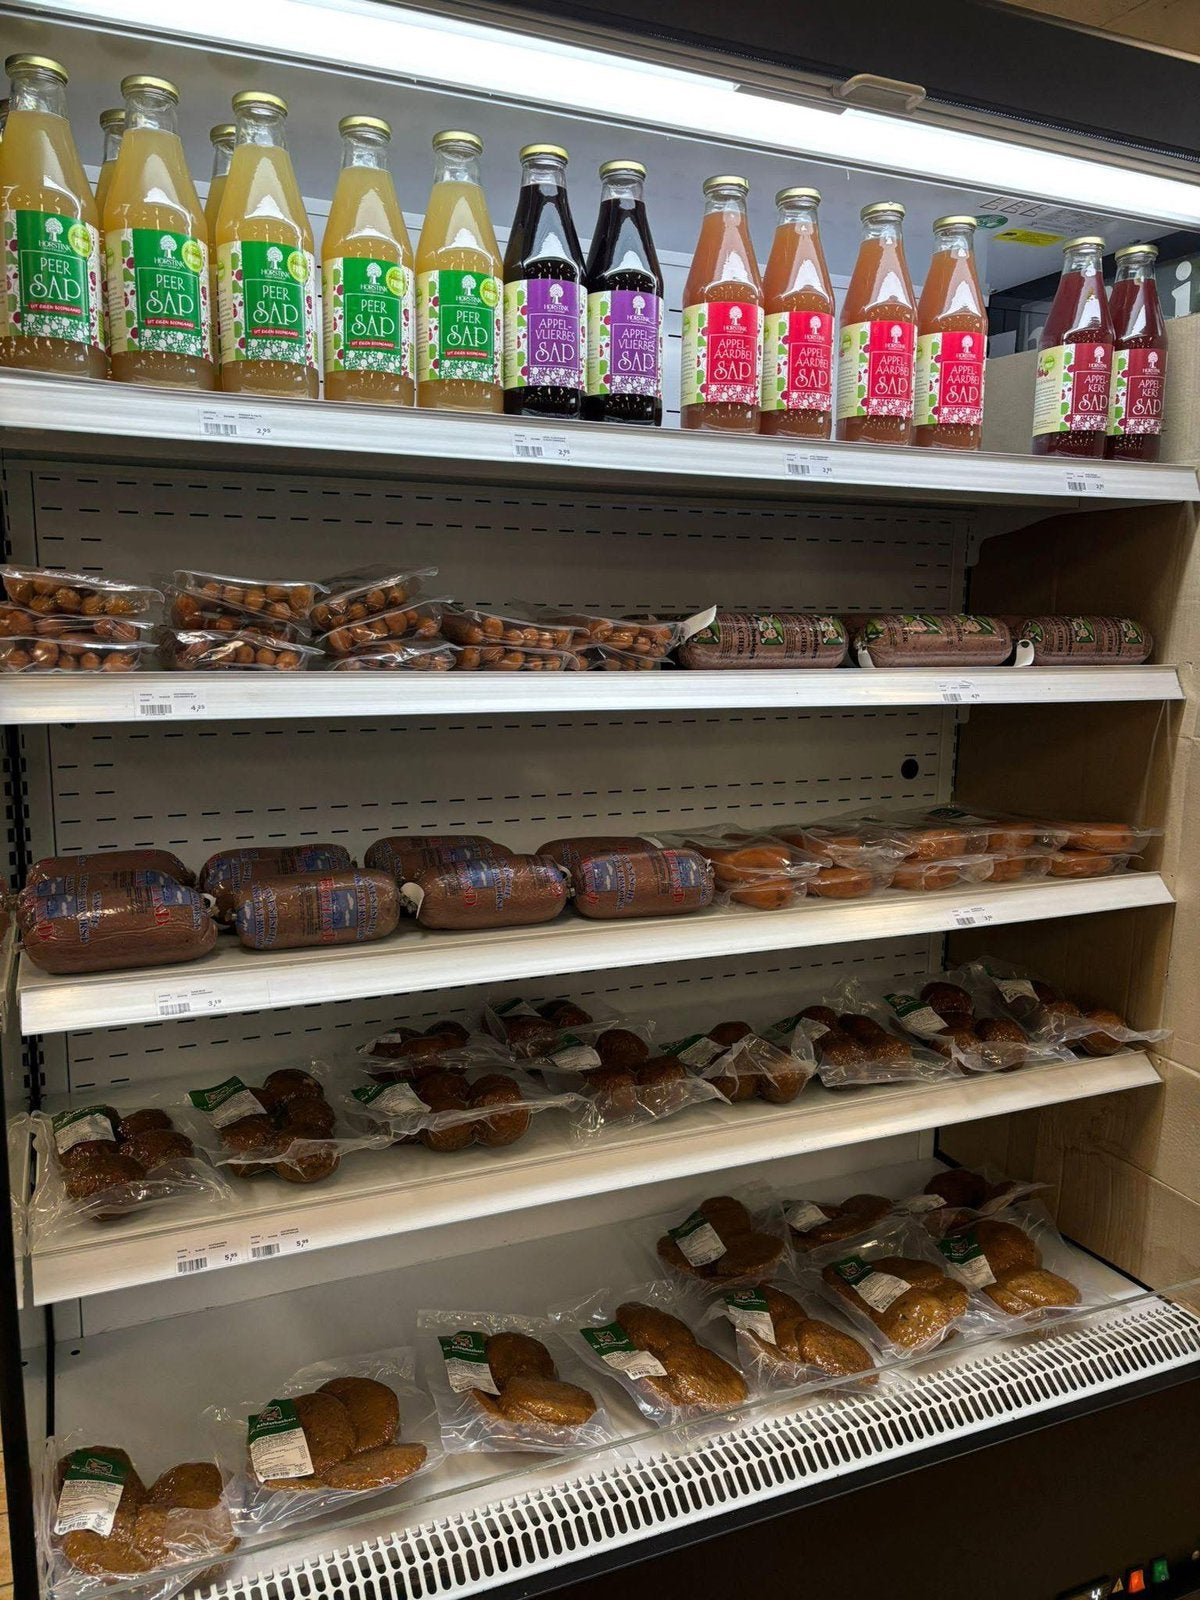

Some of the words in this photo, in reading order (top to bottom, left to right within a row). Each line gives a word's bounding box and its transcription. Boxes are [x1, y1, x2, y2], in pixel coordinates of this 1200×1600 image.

[40, 257, 72, 276] PEER
[29, 273, 82, 301] SAP
[156, 274, 186, 291] PEER
[262, 284, 290, 301] PEER
[146, 290, 194, 316] SAP
[361, 299, 387, 314] PEER
[252, 300, 298, 326] SAP
[456, 310, 481, 324] PEER
[351, 314, 394, 337] SAP
[538, 318, 572, 330] APPEL-
[446, 324, 488, 347] SAP
[535, 330, 576, 342] VLIERBES
[718, 338, 750, 349] APPEL-
[535, 342, 574, 363] SAP
[618, 350, 654, 372] SAP
[714, 349, 752, 360] AARDBEI
[714, 360, 752, 380] SAP
[795, 368, 828, 388] SAP
[875, 376, 908, 395] SAP
[946, 385, 979, 403] SAP
[1088, 384, 1105, 392] KERS
[1142, 388, 1158, 397] KERS
[1078, 393, 1108, 411] SAP
[1132, 398, 1161, 415] SAP
